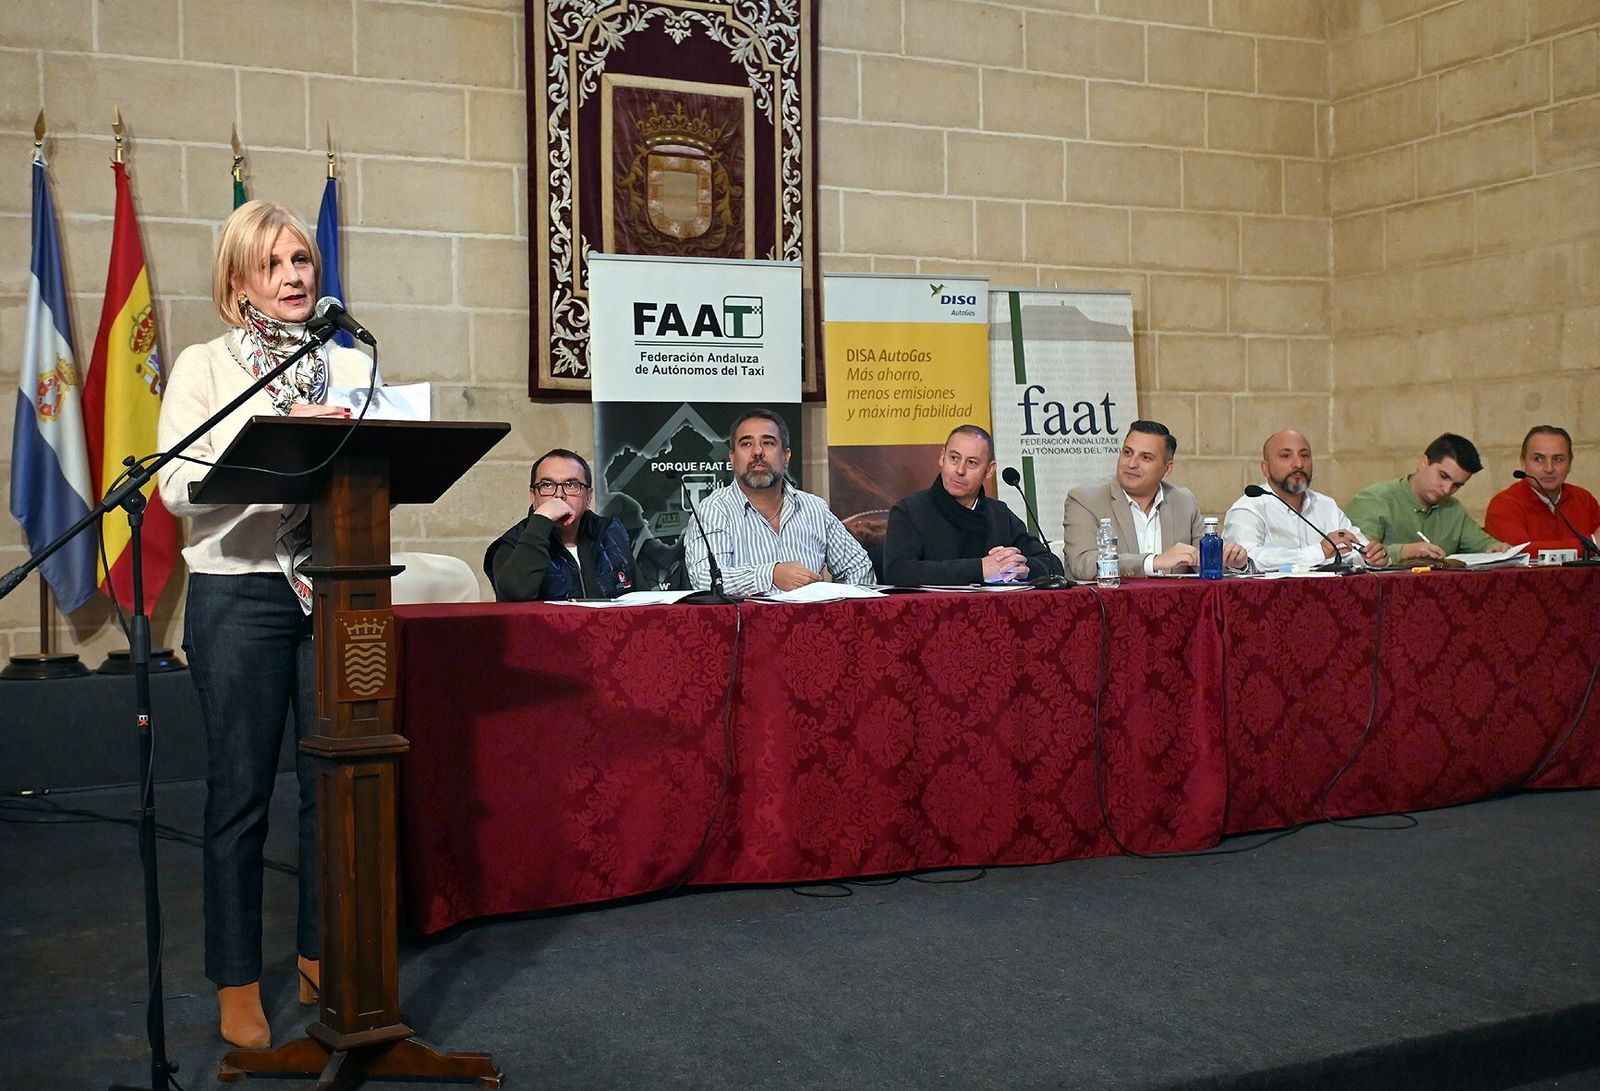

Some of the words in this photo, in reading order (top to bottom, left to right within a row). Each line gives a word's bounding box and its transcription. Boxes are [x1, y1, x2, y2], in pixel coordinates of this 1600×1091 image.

[633, 295, 764, 338] FAAT
[640, 351, 704, 362] Federación
[707, 353, 759, 363] Andaluza
[846, 349, 876, 362] DISA
[879, 349, 932, 362] AutoGas
[635, 364, 649, 374] de
[652, 364, 718, 375] Autónomos
[721, 366, 738, 375] del
[741, 366, 765, 375] Taxi
[846, 367, 874, 381] Más
[877, 368, 923, 382] ahorro,
[847, 389, 890, 400] menos
[893, 386, 955, 400] emisiones
[846, 407, 856, 421] y
[858, 404, 911, 418] máxima
[912, 403, 973, 421] fiabilidad
[1018, 385, 1119, 436] faat
[1020, 437, 1070, 446] FEDERACIÓN
[1021, 446, 1082, 455] AUTÓNOMOS
[1084, 447, 1102, 455] DEL
[699, 462, 724, 471] FAAT
